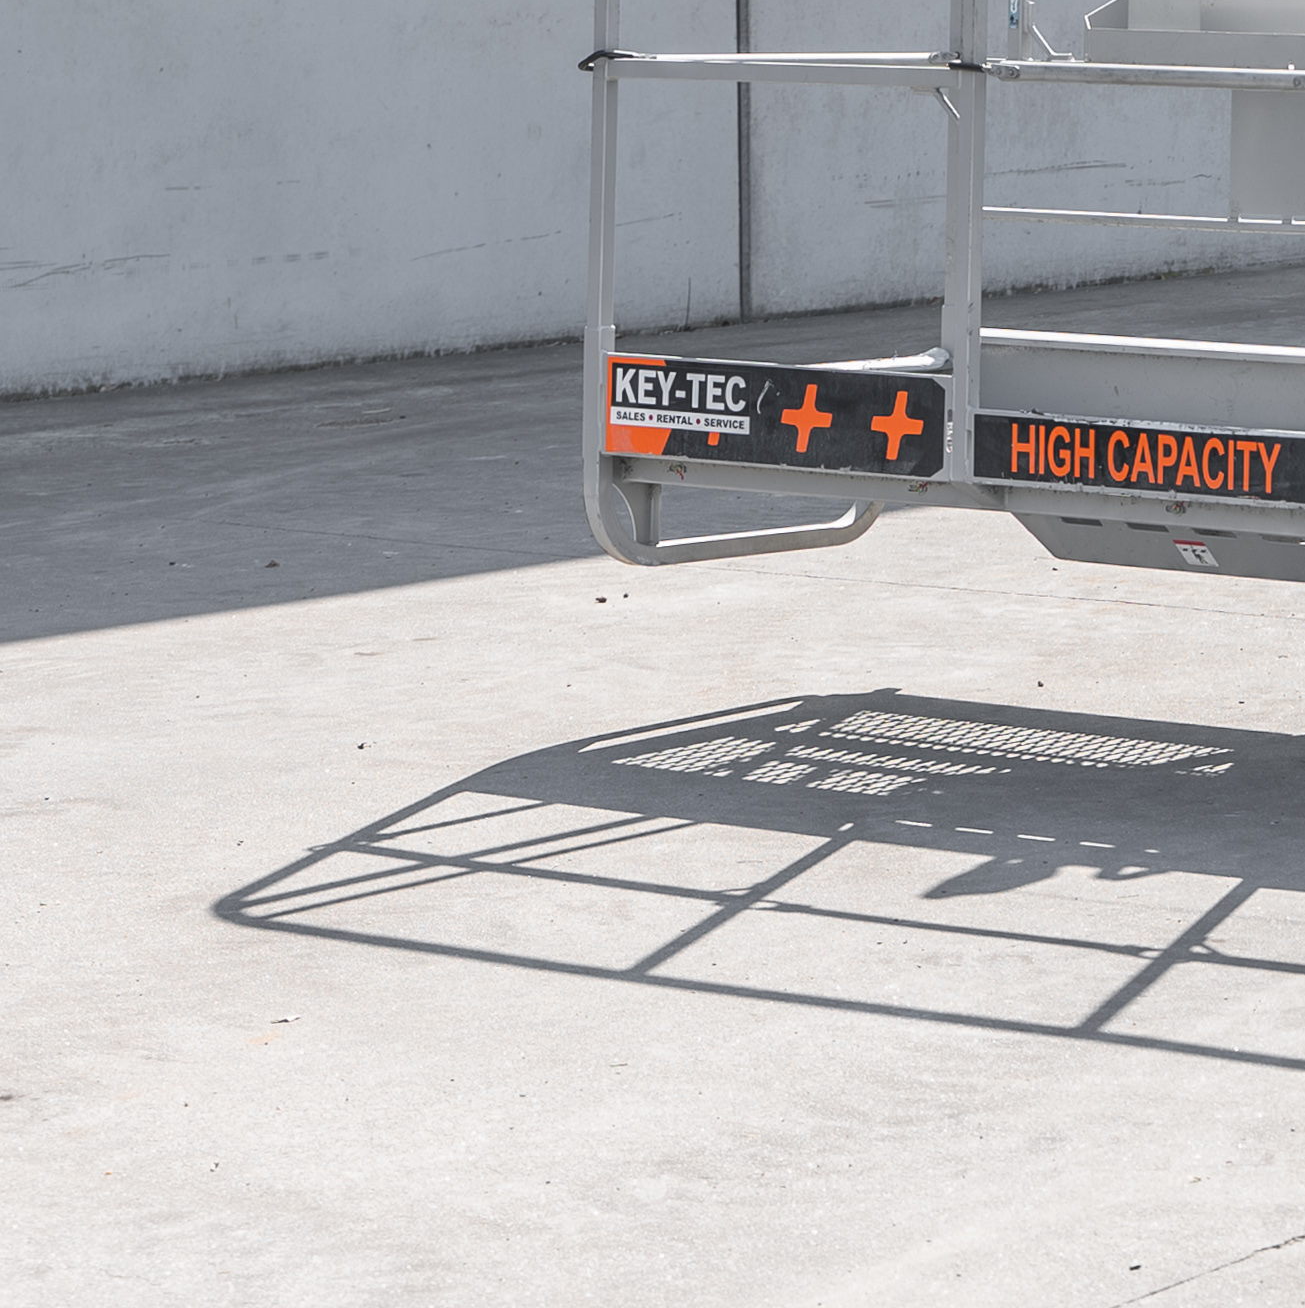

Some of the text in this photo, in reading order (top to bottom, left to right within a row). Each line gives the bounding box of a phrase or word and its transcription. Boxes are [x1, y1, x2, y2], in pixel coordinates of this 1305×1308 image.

[615, 367, 747, 413] KEY-TEC
[616, 410, 745, 430] SALES RENTAL SERVICE
[1011, 423, 1282, 494] HIGH CAPACITY
